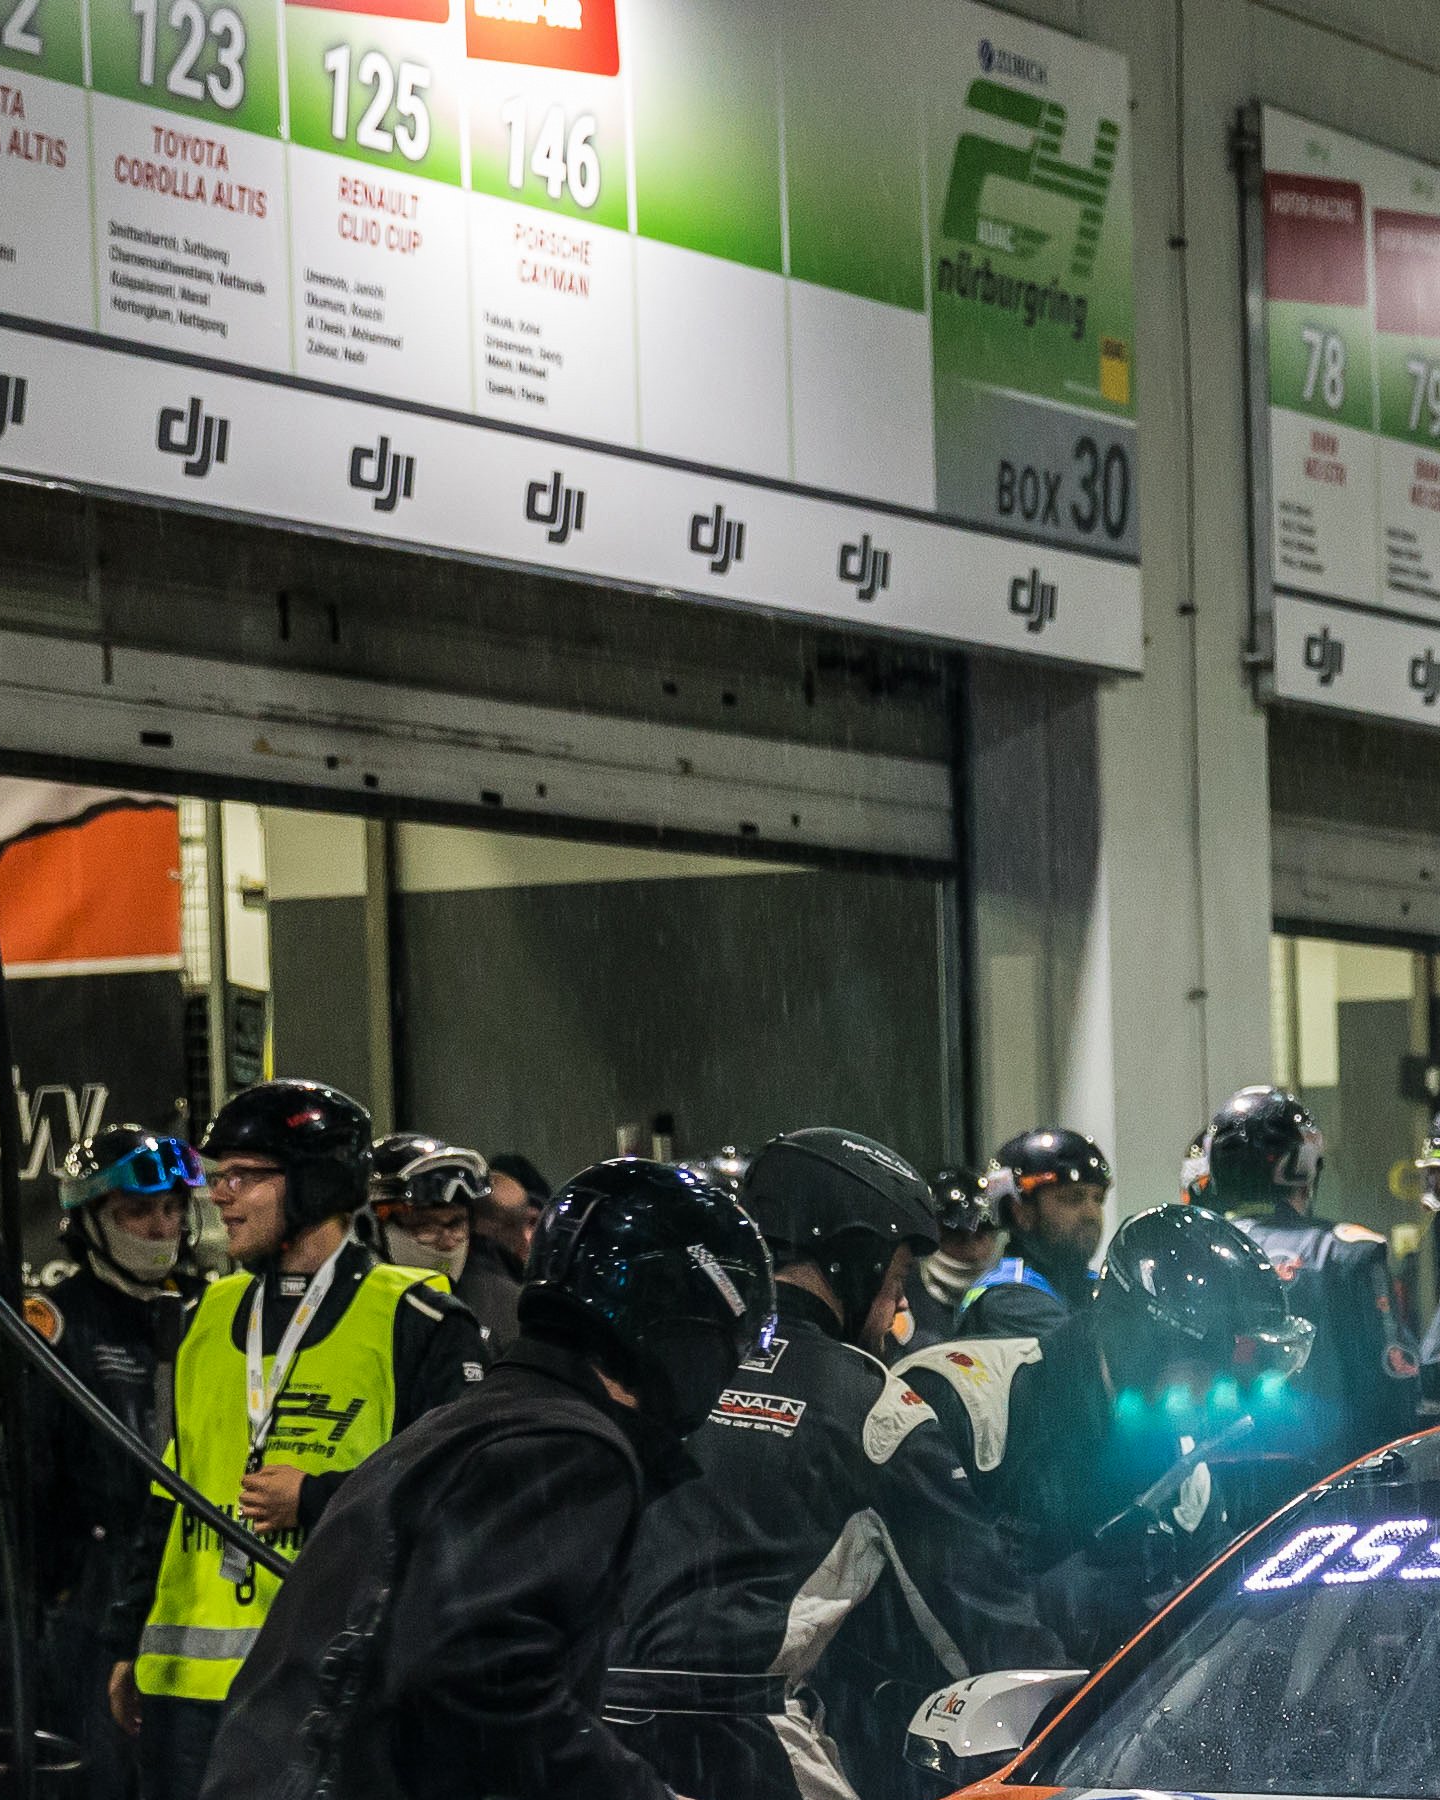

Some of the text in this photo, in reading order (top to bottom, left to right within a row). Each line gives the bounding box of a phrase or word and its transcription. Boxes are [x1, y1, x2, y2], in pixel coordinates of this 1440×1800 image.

[134, 0, 247, 110] 123
[323, 42, 433, 162] 125
[7, 128, 68, 169] ALTIS
[151, 125, 229, 172] TOYOTA
[501, 95, 602, 209] 146
[113, 155, 268, 220] COROLLA ALTIS
[338, 176, 419, 219] RENAULT
[338, 212, 422, 255] CLIO CUP
[519, 259, 590, 298] CAYMAN
[938, 251, 1088, 340] nürburgring
[1301, 326, 1345, 409] 78
[995, 436, 1130, 542] BOX 30
